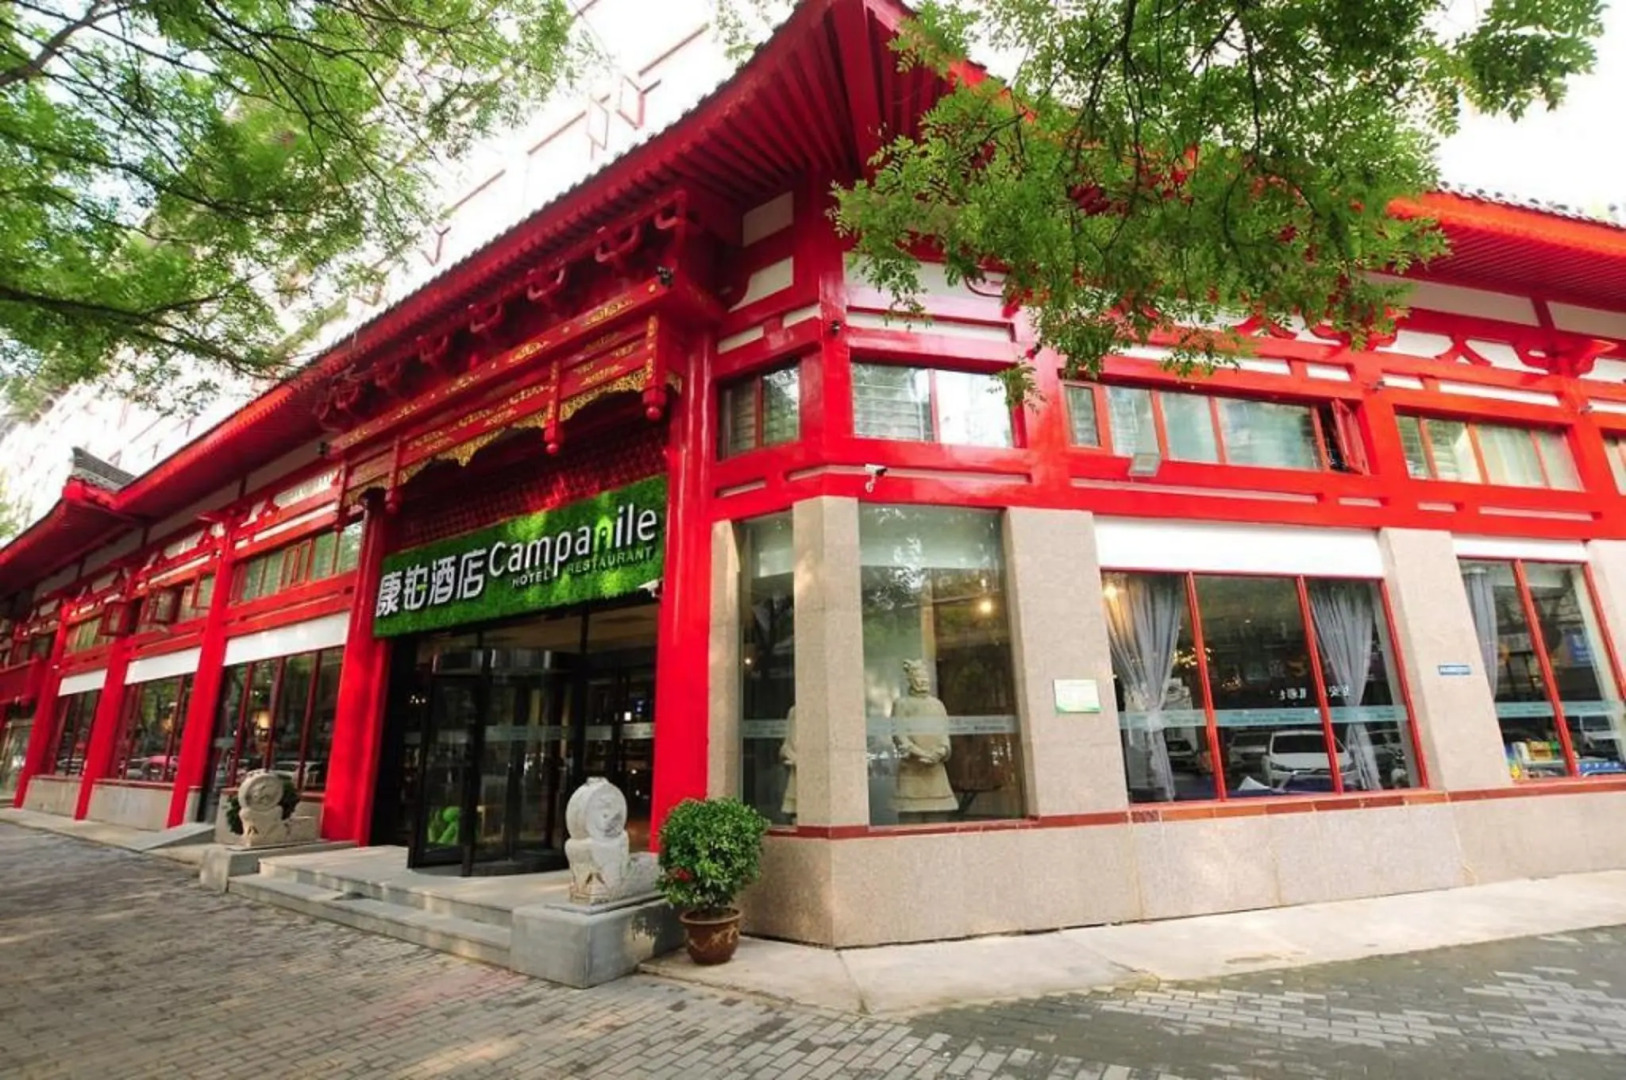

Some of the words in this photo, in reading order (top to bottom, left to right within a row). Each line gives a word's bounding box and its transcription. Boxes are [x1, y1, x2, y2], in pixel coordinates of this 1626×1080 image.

[488, 503, 657, 577] Campanile
[512, 570, 549, 588] HOTEL
[566, 546, 653, 574] RESTAURANT
[376, 548, 487, 617] 康铂酒店
